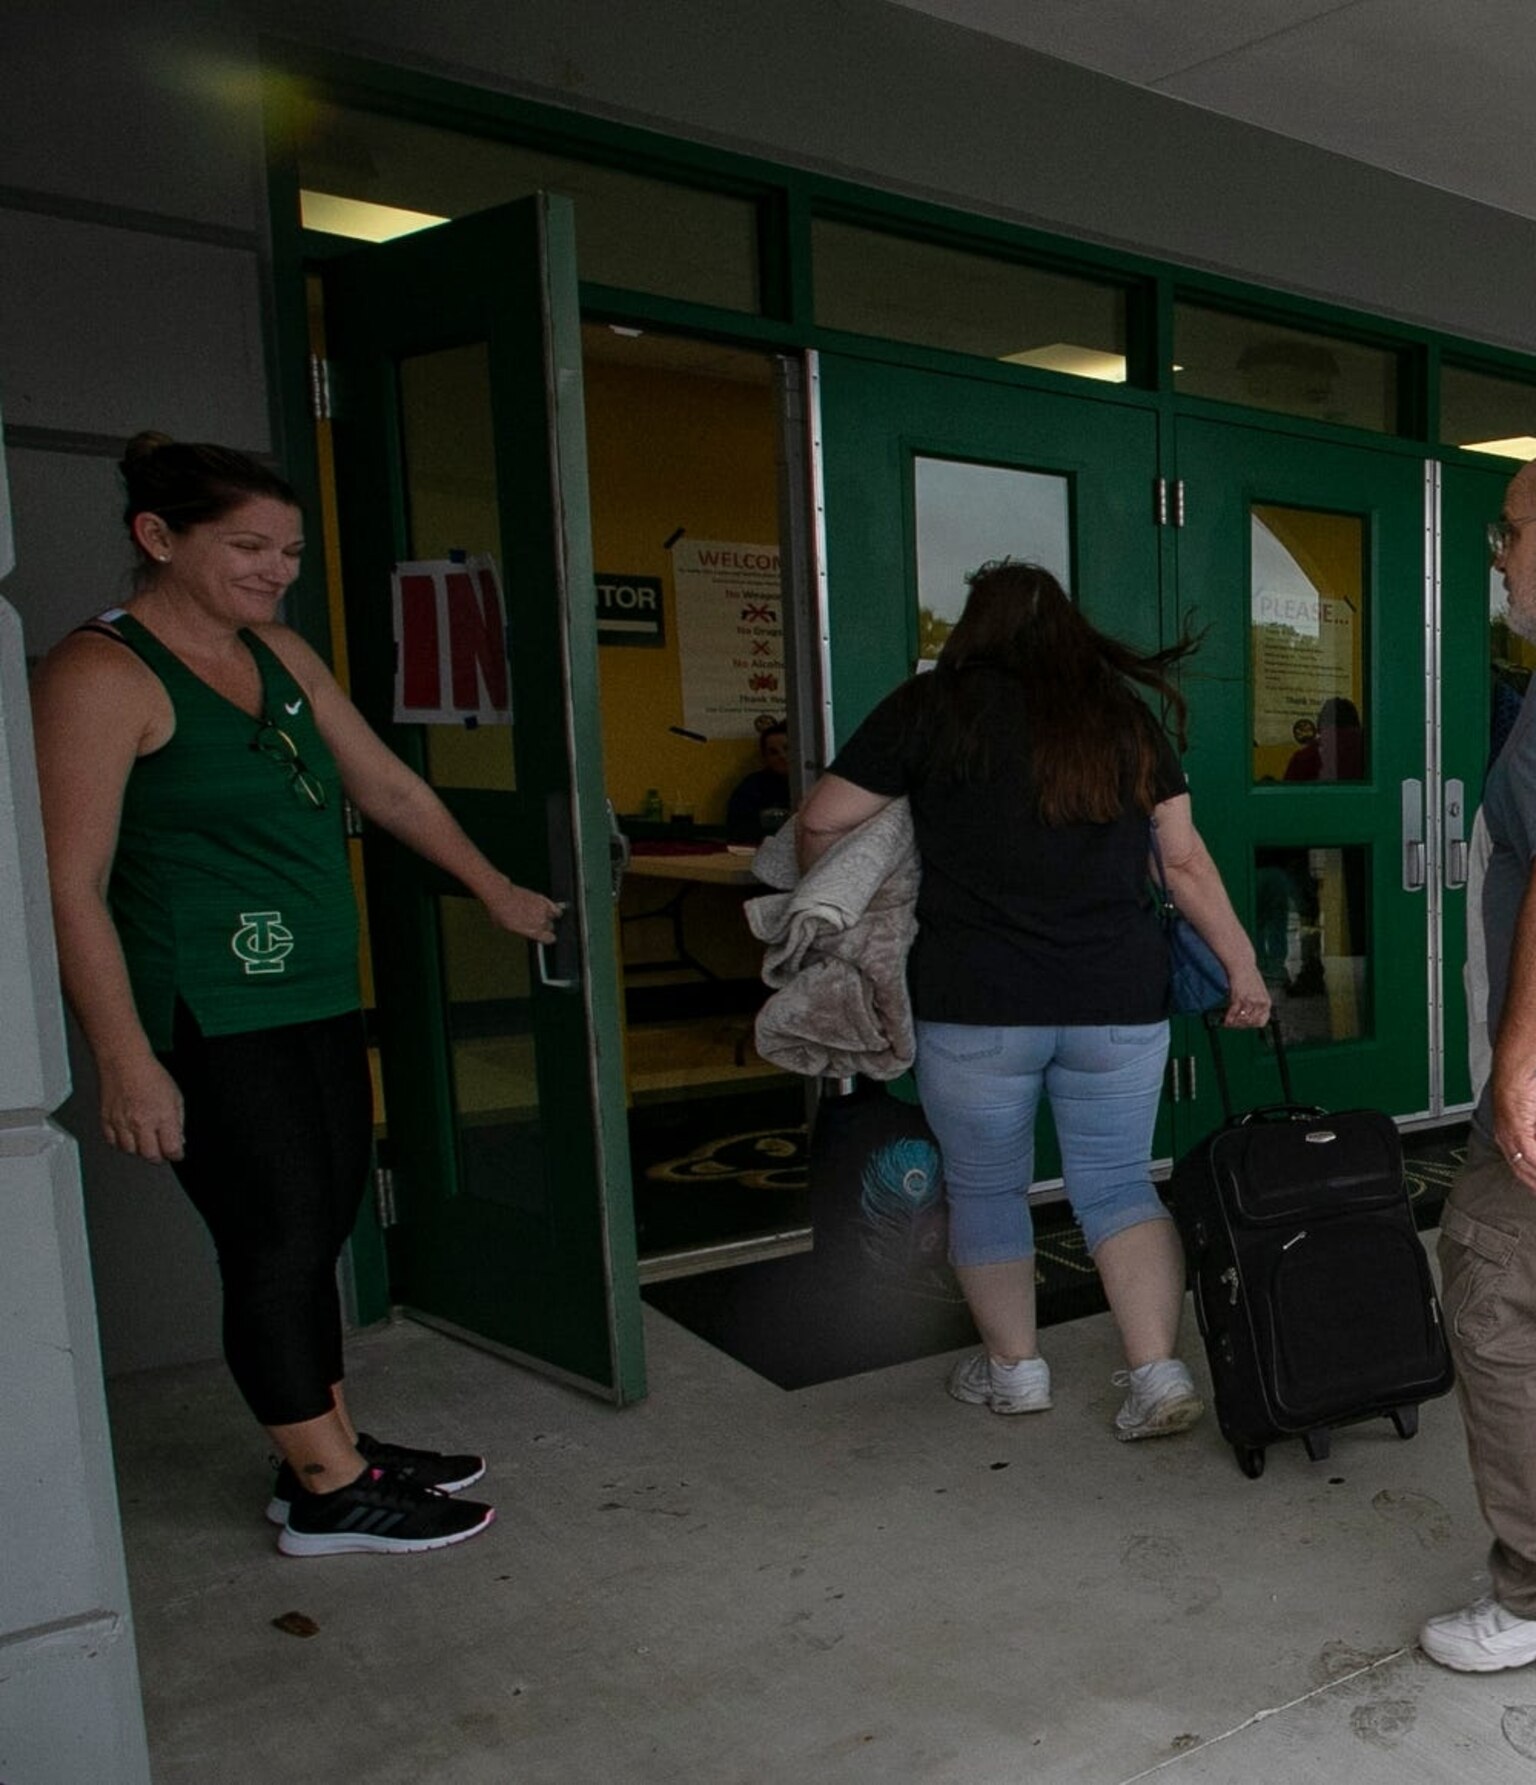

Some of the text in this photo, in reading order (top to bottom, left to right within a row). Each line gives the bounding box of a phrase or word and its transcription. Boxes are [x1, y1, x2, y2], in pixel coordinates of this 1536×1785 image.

[596, 585, 657, 609] TOR
[1260, 597, 1349, 625] PLEASE...
[400, 569, 508, 711] IN
